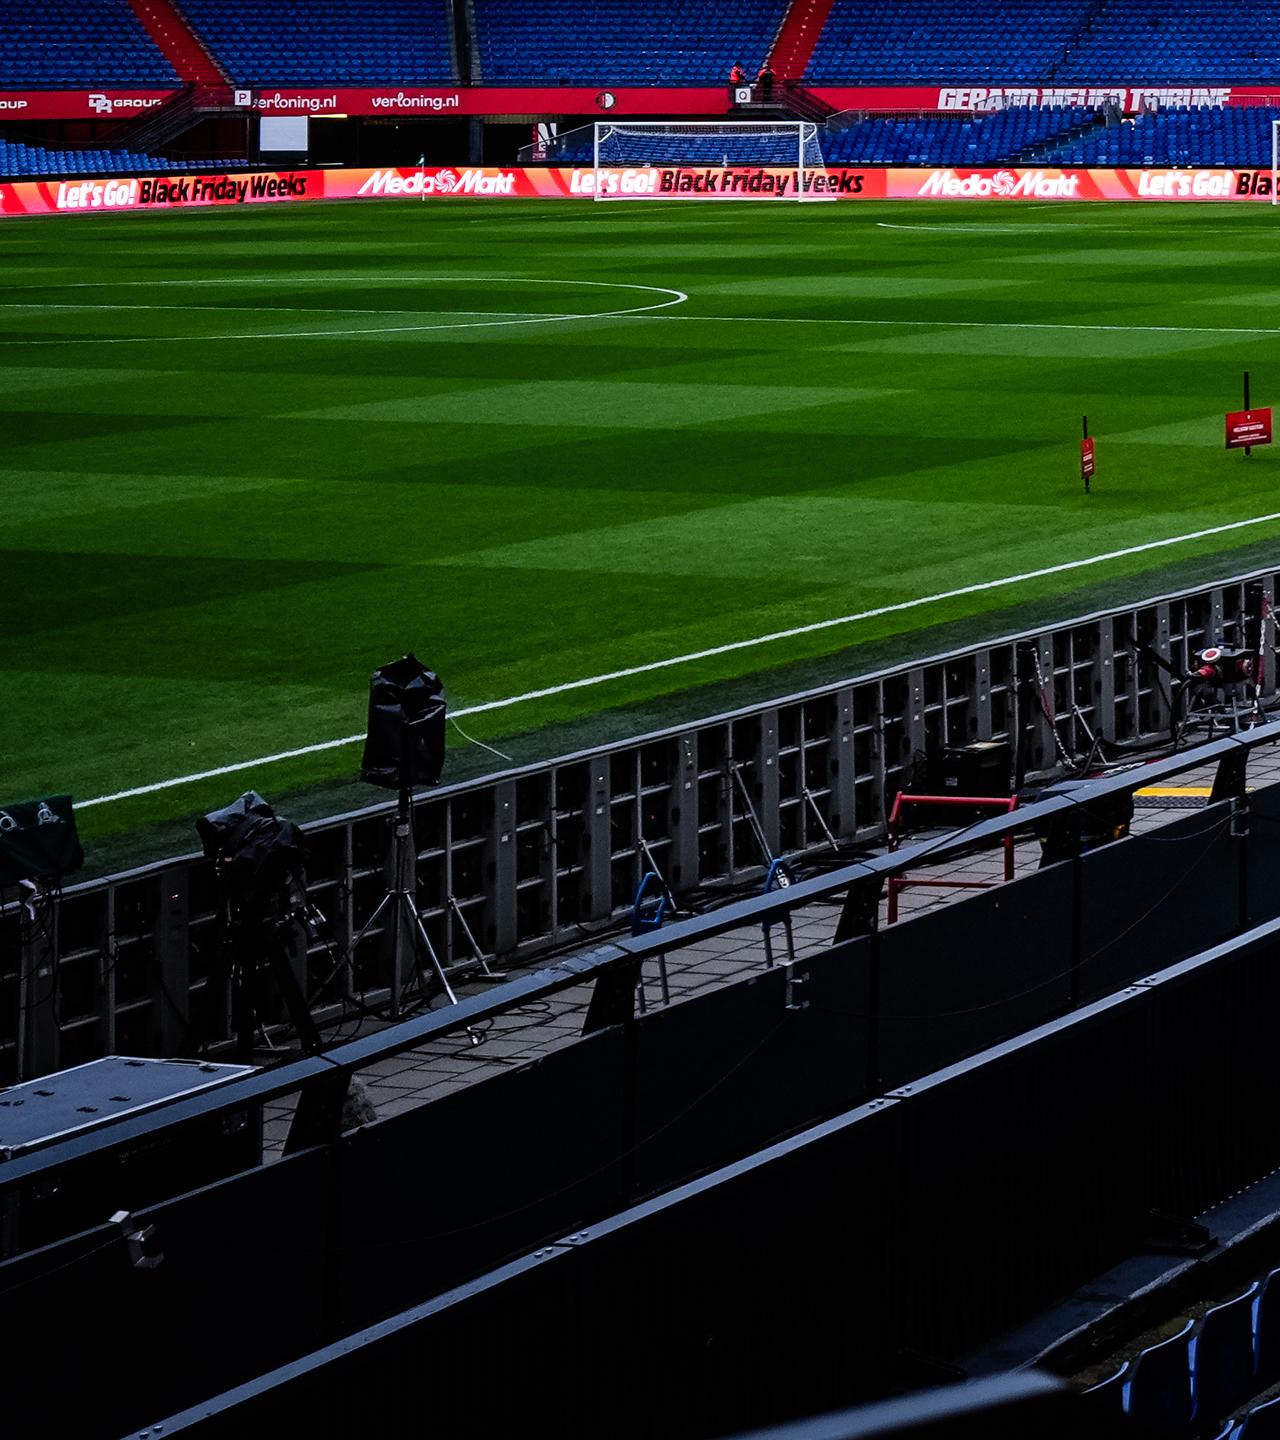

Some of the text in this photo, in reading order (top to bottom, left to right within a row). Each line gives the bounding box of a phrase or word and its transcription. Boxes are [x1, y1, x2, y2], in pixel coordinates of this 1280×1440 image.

[239, 93, 247, 103] P
[372, 92, 459, 110] verloning.nl
[739, 91, 748, 100] Q
[57, 173, 307, 209] Let's Go! Black Friday Weeks
[621, 168, 656, 193] Go!
[660, 170, 716, 193] Black
[720, 170, 790, 197] Friday
[1138, 170, 1190, 196] Let's
[1193, 170, 1233, 196] Go!
